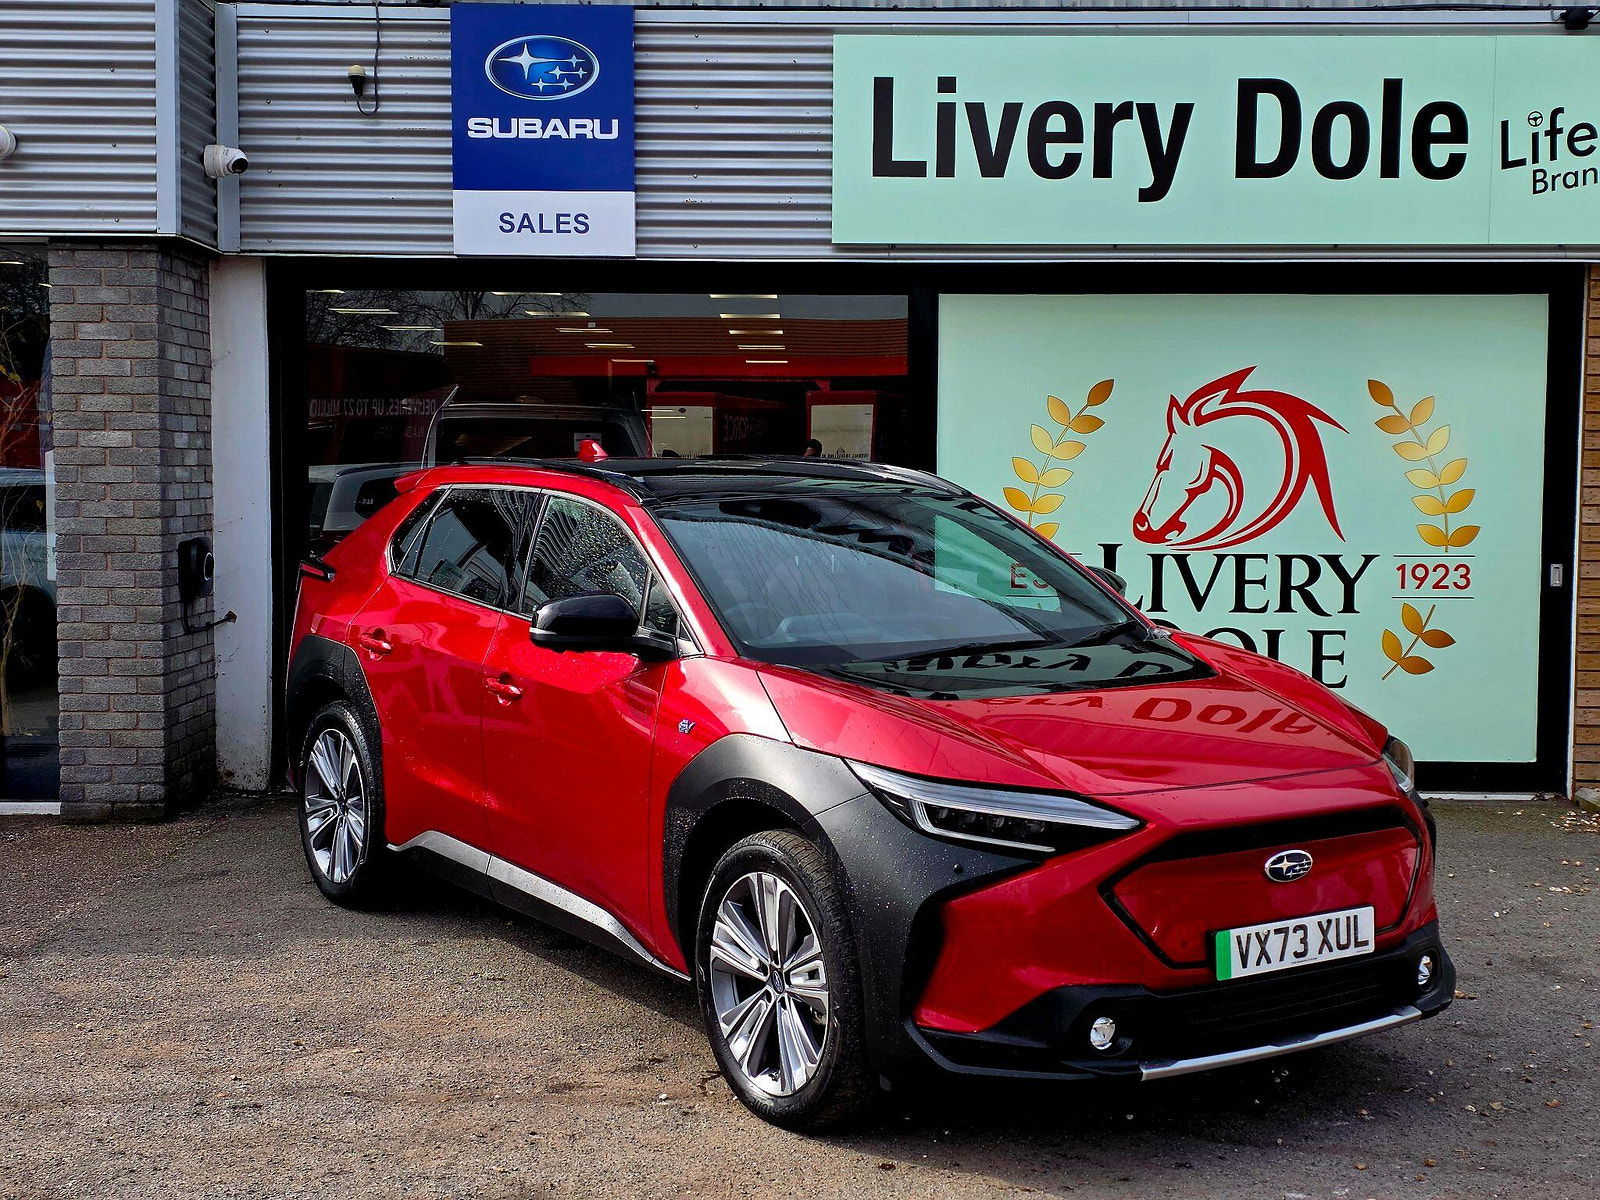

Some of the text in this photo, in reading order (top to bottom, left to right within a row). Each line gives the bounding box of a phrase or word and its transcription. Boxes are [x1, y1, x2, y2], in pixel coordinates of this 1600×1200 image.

[467, 117, 619, 140] SUBARU
[873, 77, 1468, 202] Livery Dole
[499, 212, 590, 234] SALES
[1396, 563, 1471, 589] 1923
[1236, 914, 1370, 969] VX73 XUL
